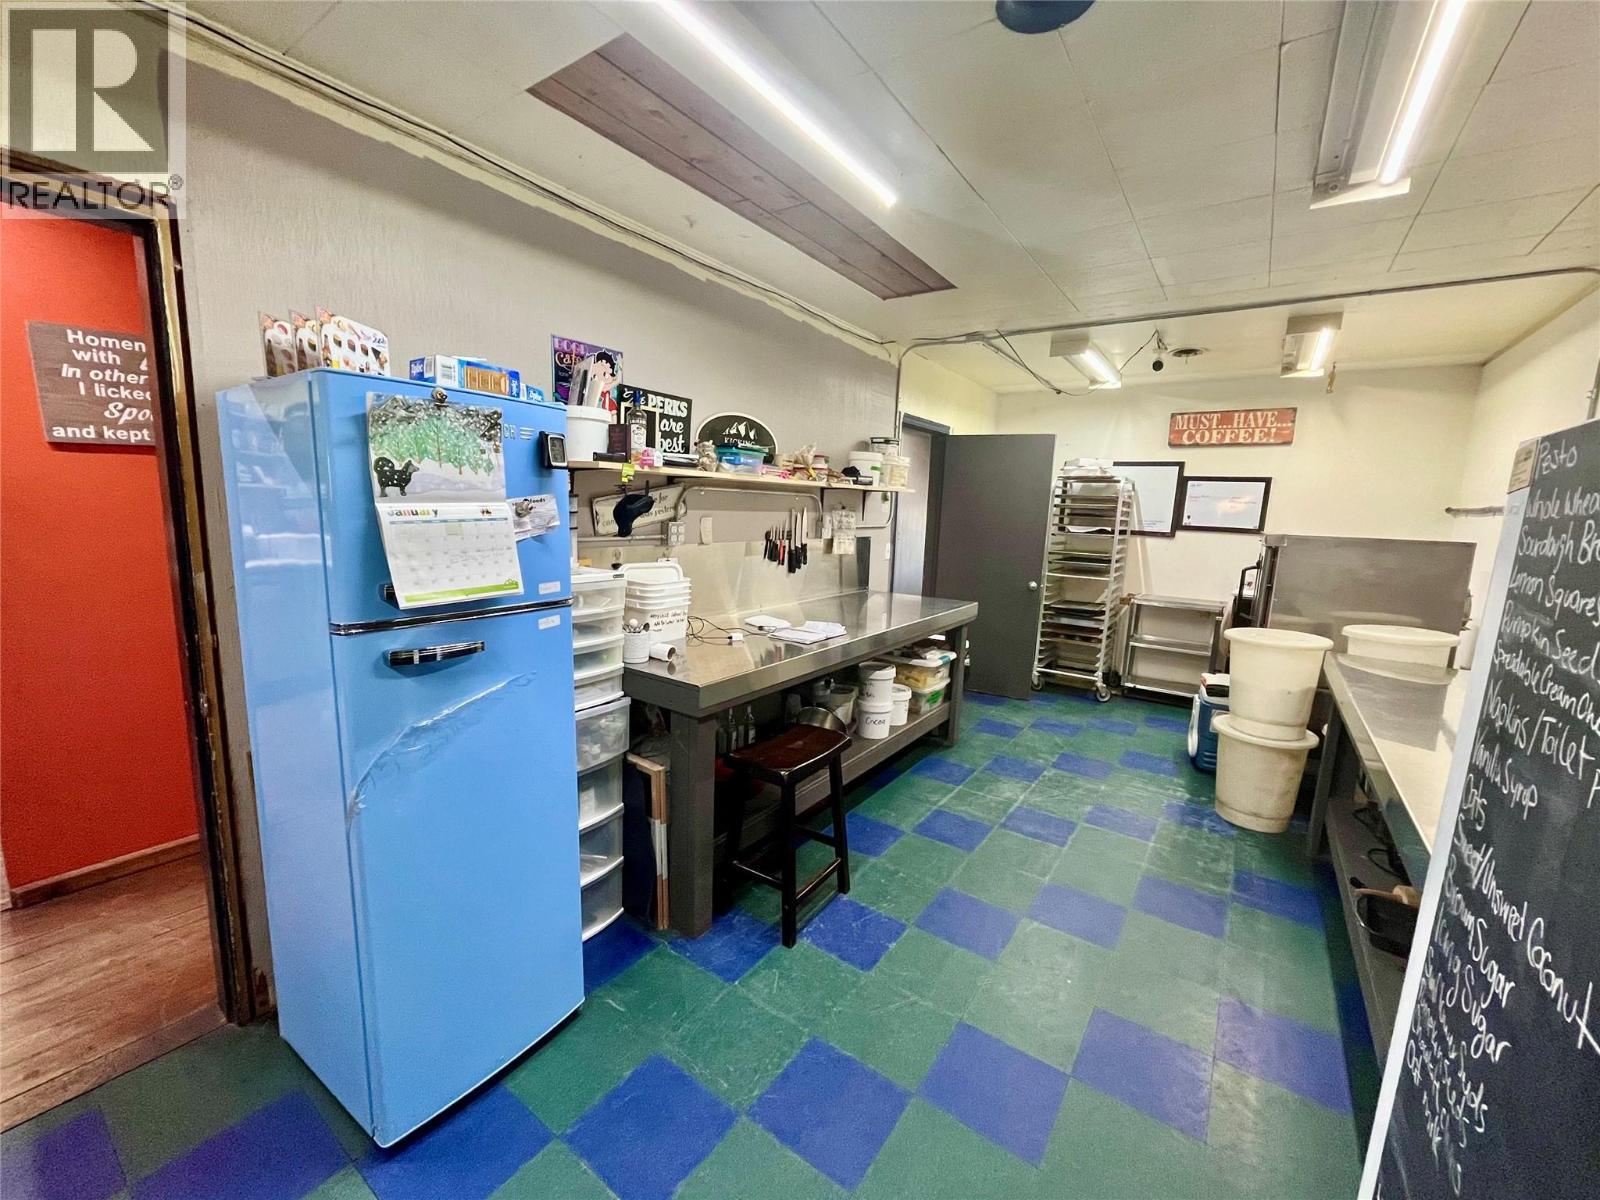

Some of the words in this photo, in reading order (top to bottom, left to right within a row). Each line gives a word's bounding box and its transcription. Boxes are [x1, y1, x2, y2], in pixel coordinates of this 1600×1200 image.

[61, 363, 81, 378] In
[89, 367, 148, 384] other
[72, 348, 121, 365] with
[79, 381, 85, 395] I
[647, 393, 688, 418] PERKS
[104, 401, 154, 425] Spo
[660, 418, 684, 433] are
[52, 424, 96, 438] and
[102, 425, 151, 443] kept
[1182, 427, 1277, 444] COFFEE!
[1535, 440, 1577, 480] Pesto
[1509, 565, 1543, 603] Lemon
[1502, 599, 1549, 657] Pumpkin
[1540, 664, 1576, 716] Cream
[1462, 773, 1488, 831] Oats
[1501, 757, 1538, 820] Syrup
[1472, 918, 1516, 1009] Sugar
[1527, 917, 1600, 1053] Coconut
[1461, 964, 1512, 1064] Sugar
